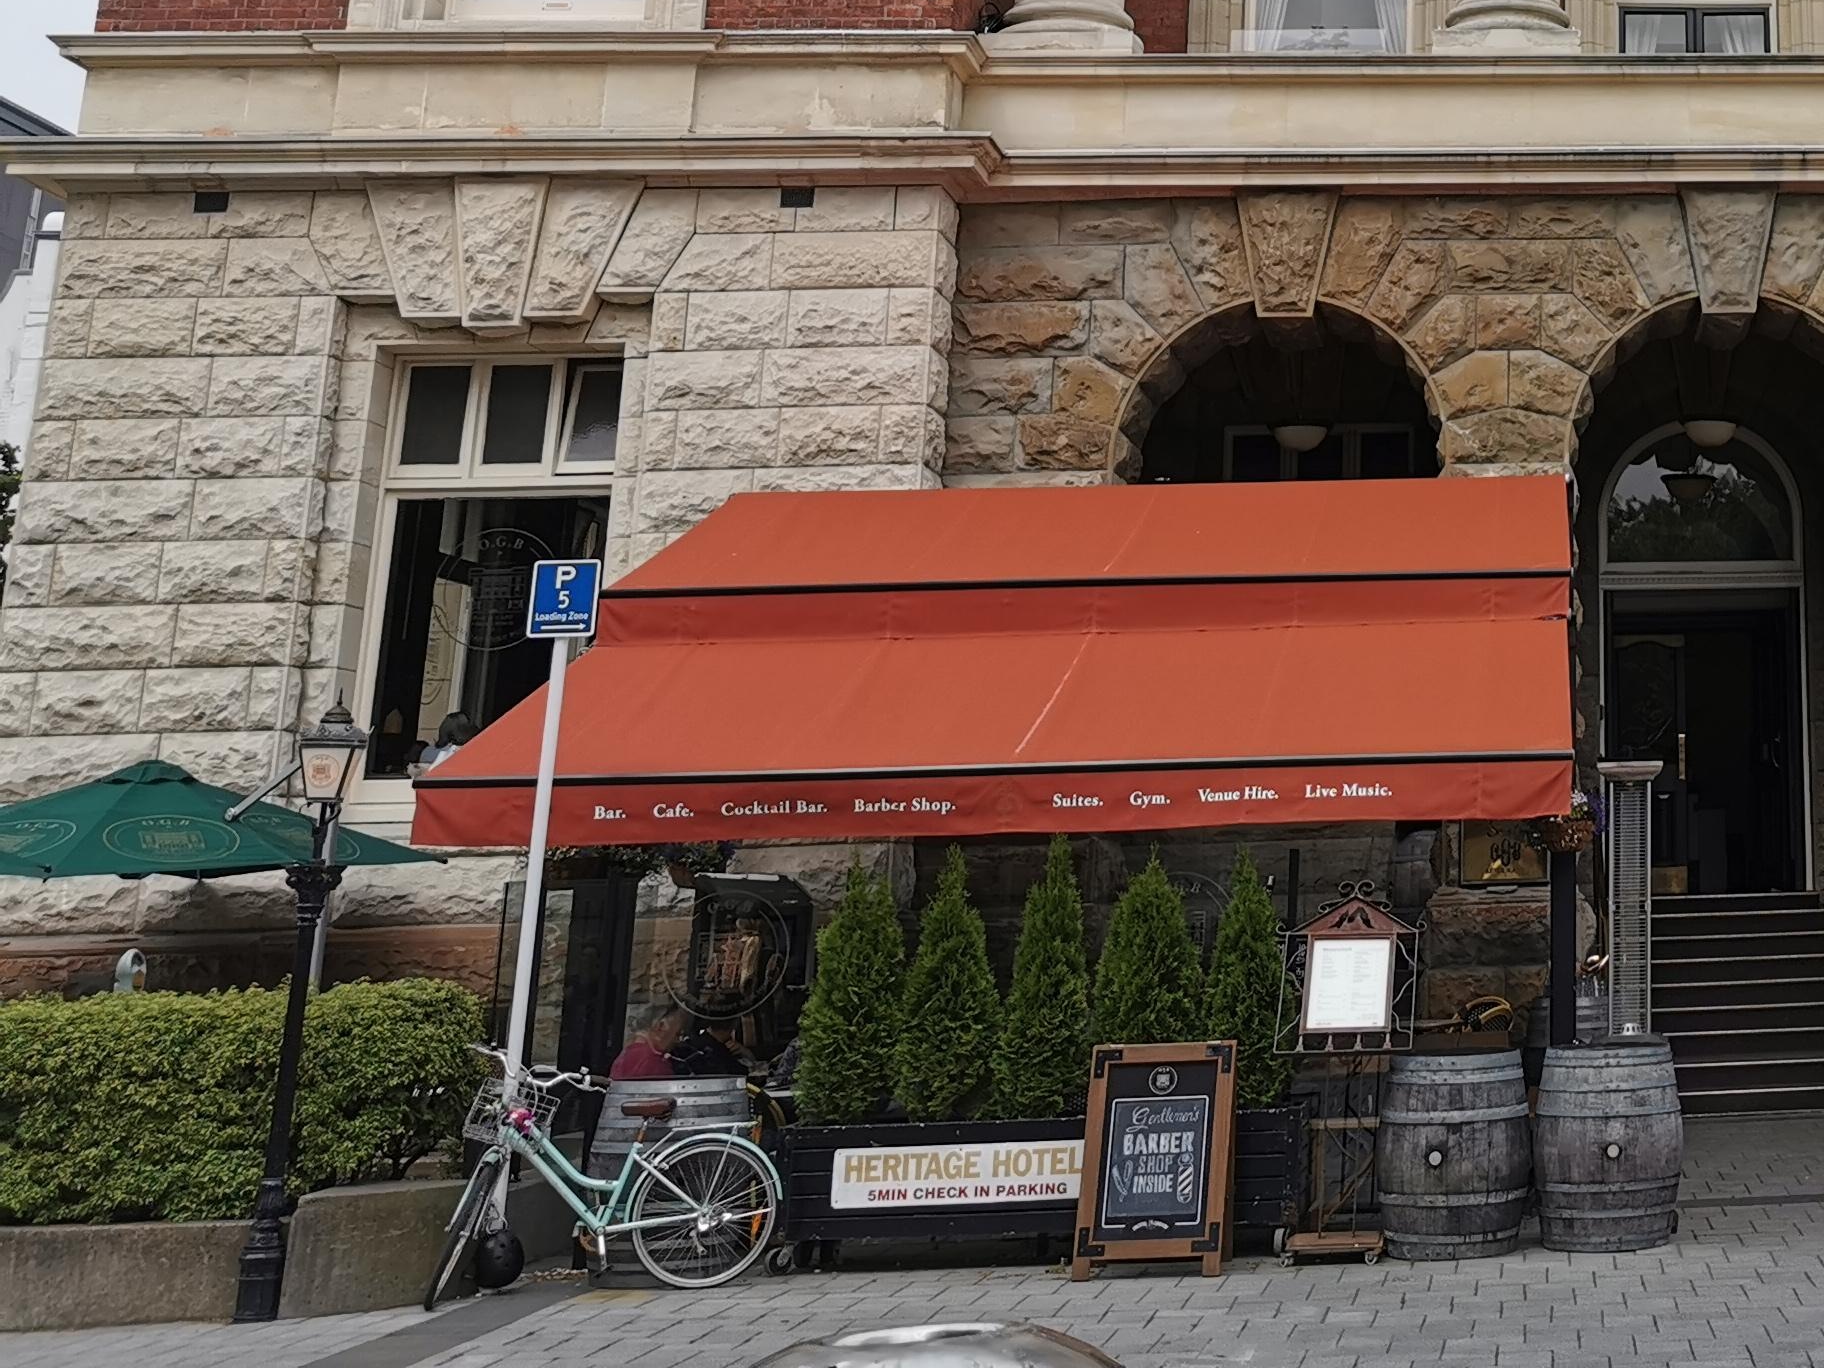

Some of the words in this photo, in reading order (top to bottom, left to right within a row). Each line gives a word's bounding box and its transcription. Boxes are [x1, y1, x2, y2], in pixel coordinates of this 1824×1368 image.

[555, 566, 577, 589] P
[558, 591, 570, 609] 5
[535, 612, 567, 621] Loading
[568, 612, 589, 620] Zone
[593, 805, 626, 820] Bar.
[653, 802, 694, 819] Cafe.
[720, 800, 790, 816] Cocktail
[796, 800, 828, 814] Bar.
[854, 798, 907, 812] Barber
[911, 797, 956, 815] Shop.
[1052, 793, 1104, 808] Suites.
[1129, 791, 1171, 809] Gym.
[1198, 787, 1240, 802] Venue
[1243, 785, 1279, 800] Hire.
[1305, 784, 1337, 798] Live
[1342, 782, 1393, 797] Music.
[1126, 1105, 1201, 1132] Gentlemen's
[1123, 1131, 1195, 1156] BARBER
[843, 1150, 982, 1183] HERITAGE
[992, 1146, 1082, 1178] HOTEL
[1138, 1154, 1175, 1174] SHOP
[867, 1188, 907, 1201] 5MIN
[913, 1186, 968, 1200] CHECK
[974, 1185, 990, 1197] IN
[996, 1182, 1067, 1196] PARKING
[1132, 1175, 1174, 1194] INSIDE
